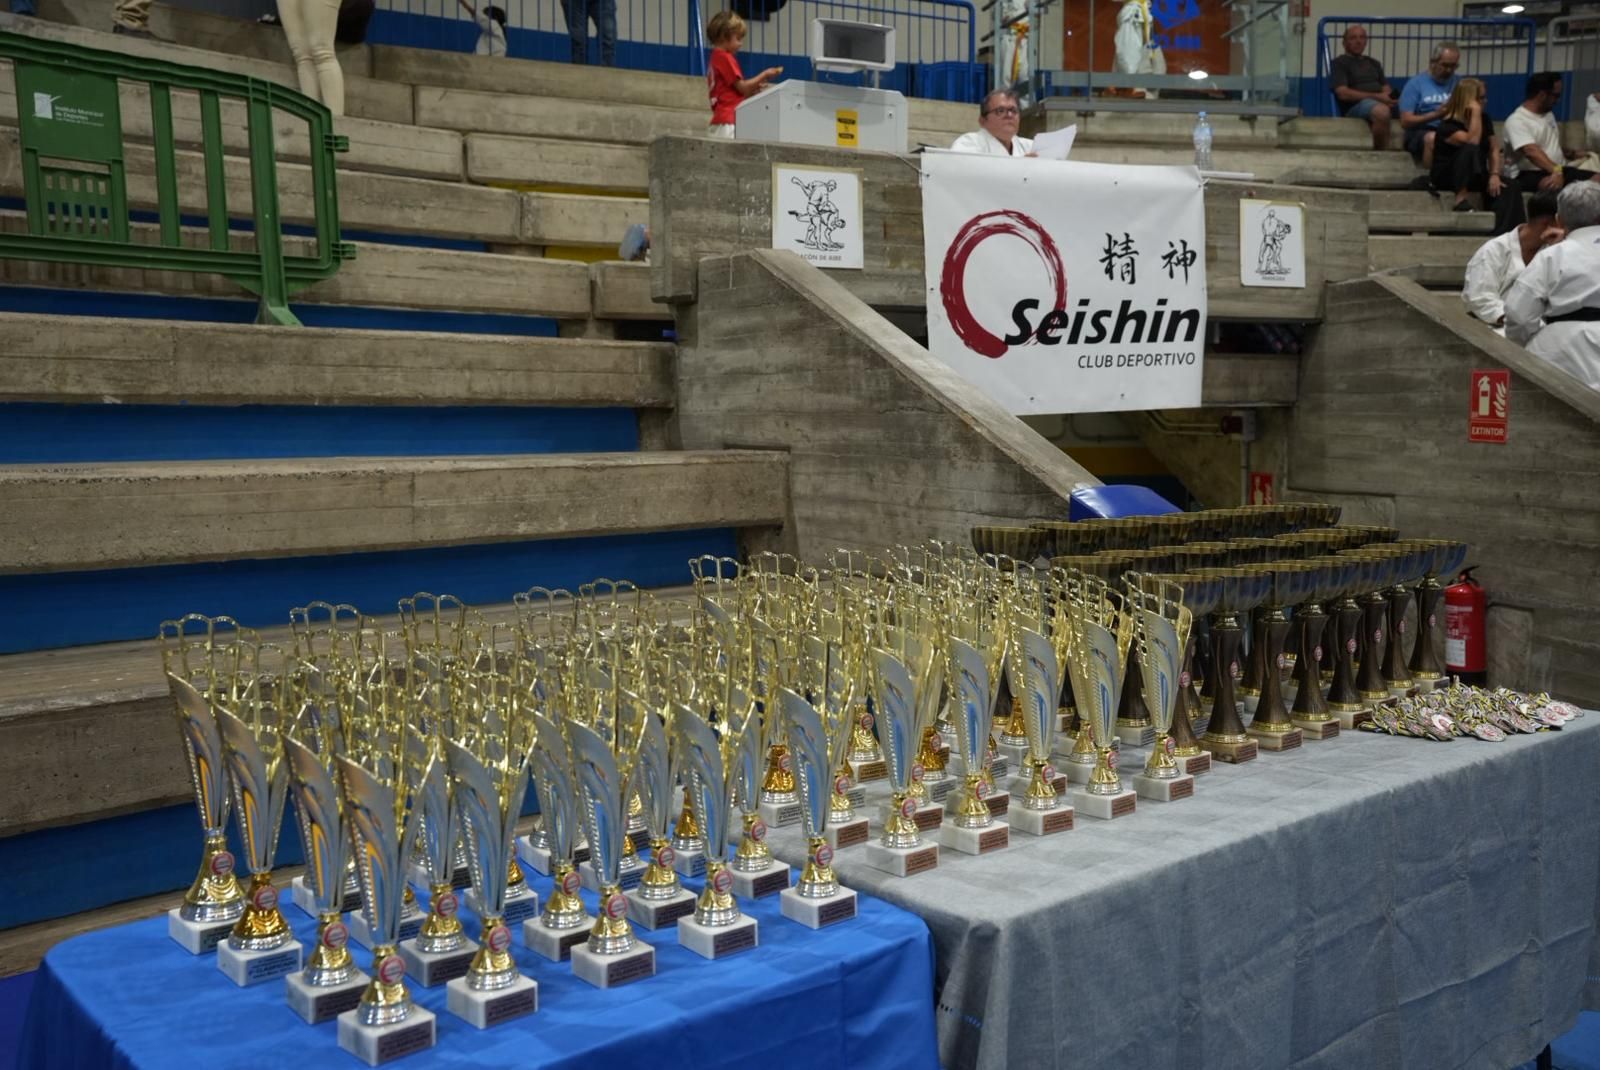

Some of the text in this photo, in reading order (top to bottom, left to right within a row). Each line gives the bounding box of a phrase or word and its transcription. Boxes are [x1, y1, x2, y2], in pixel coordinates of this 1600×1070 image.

[1005, 298, 1200, 346] Seishin
[1078, 352, 1196, 369] CLUB DEPORTIVO
[1471, 426, 1505, 436] EXTINTOR
